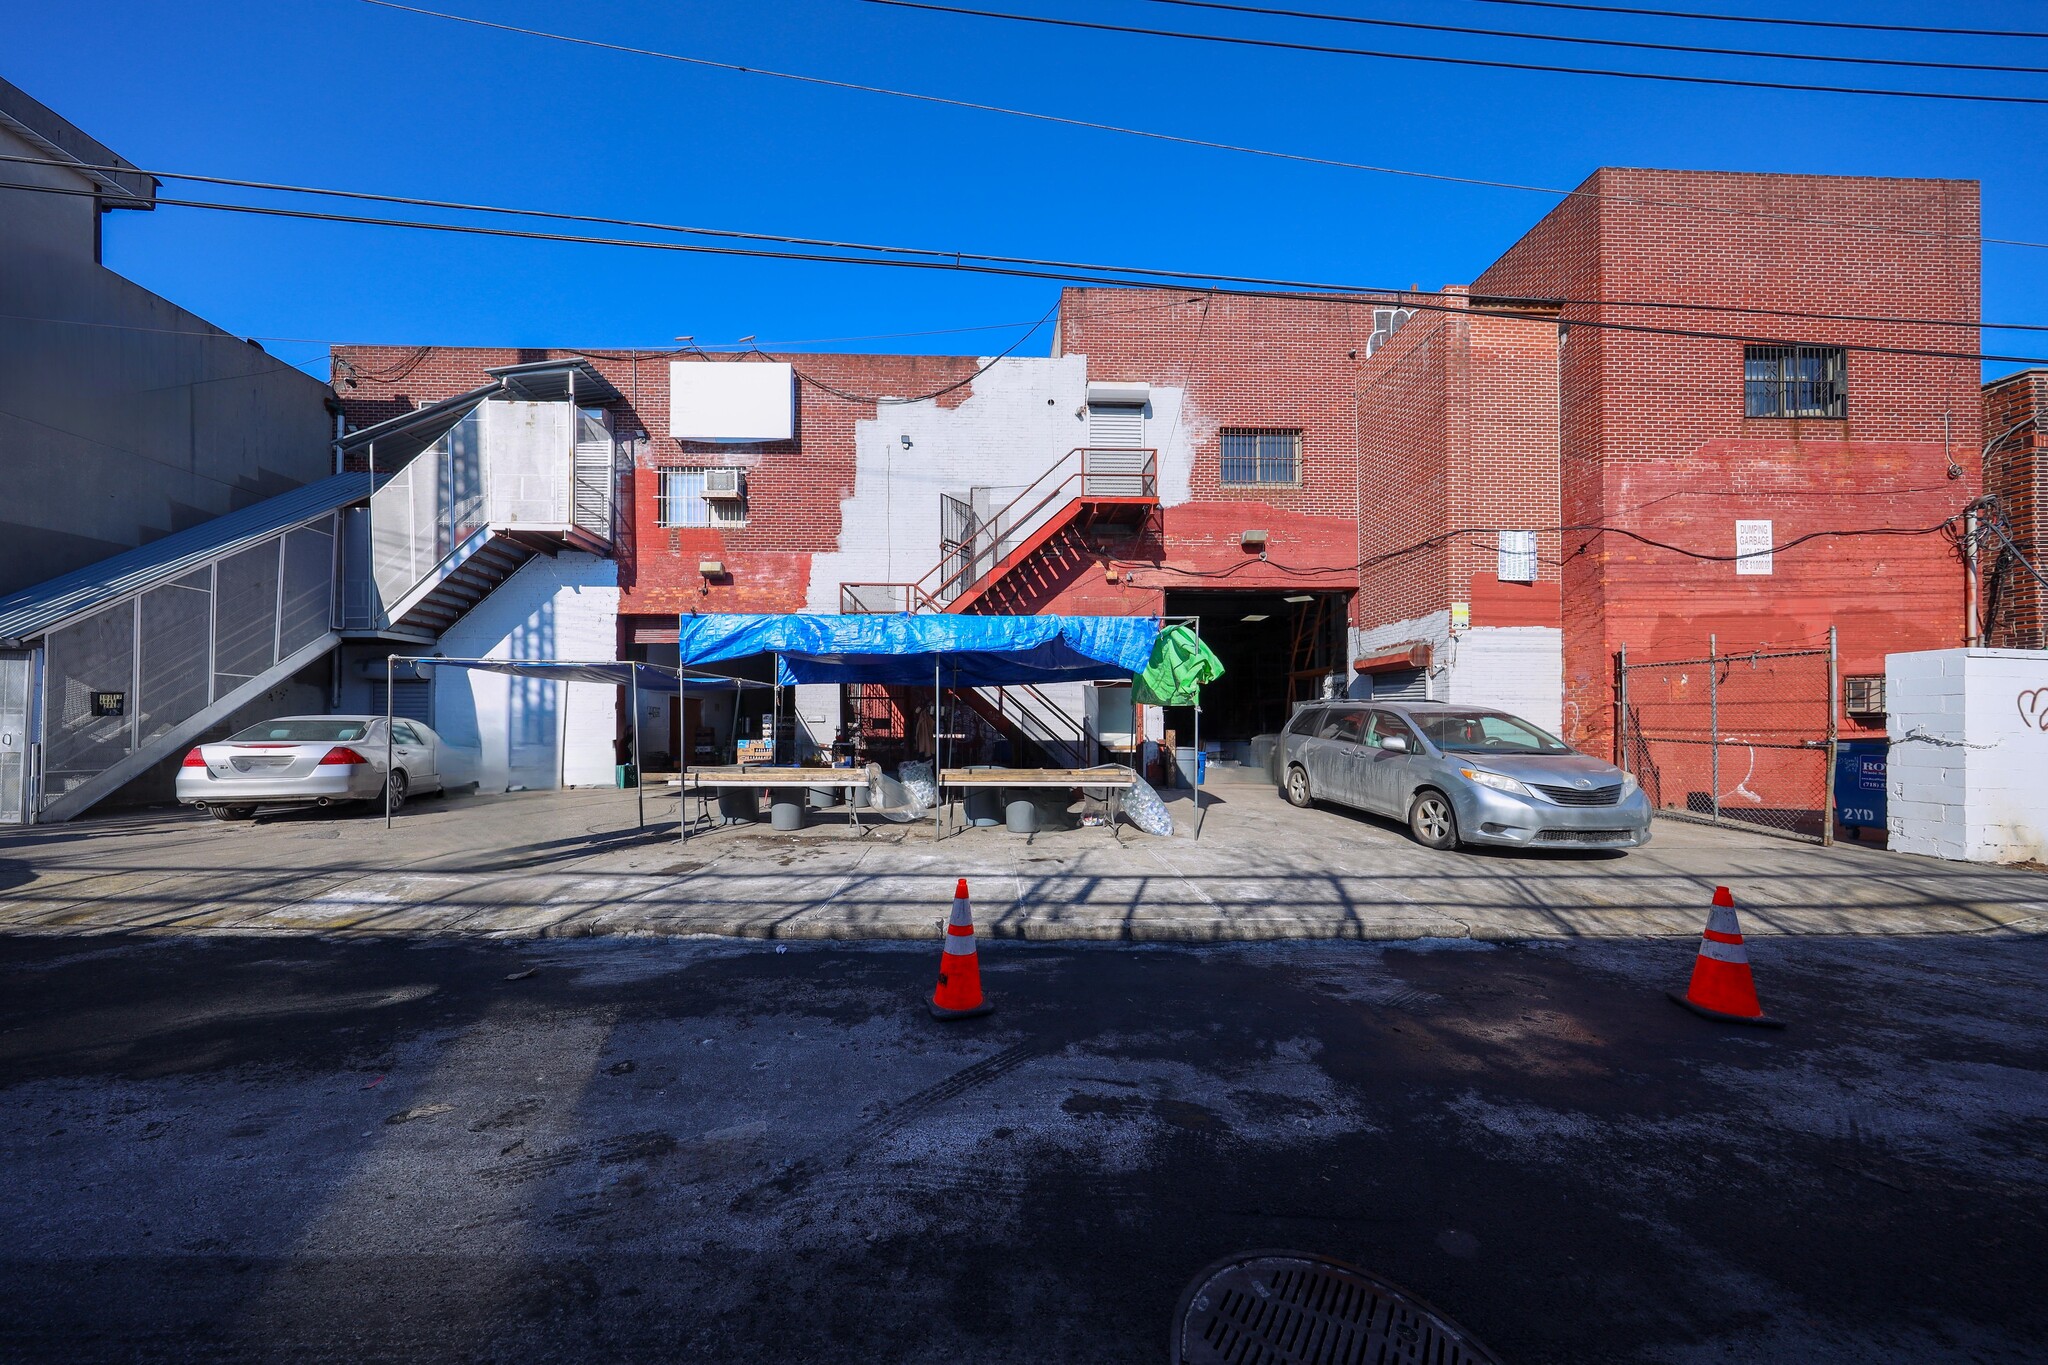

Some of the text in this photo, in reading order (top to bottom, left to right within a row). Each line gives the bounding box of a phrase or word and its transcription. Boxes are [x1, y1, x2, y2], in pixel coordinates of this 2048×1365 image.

[1740, 525, 1768, 534] DUMPING
[1740, 536, 1769, 545] GARBAGE
[1862, 762, 1887, 771] RO
[1843, 808, 1874, 820] 2YD
